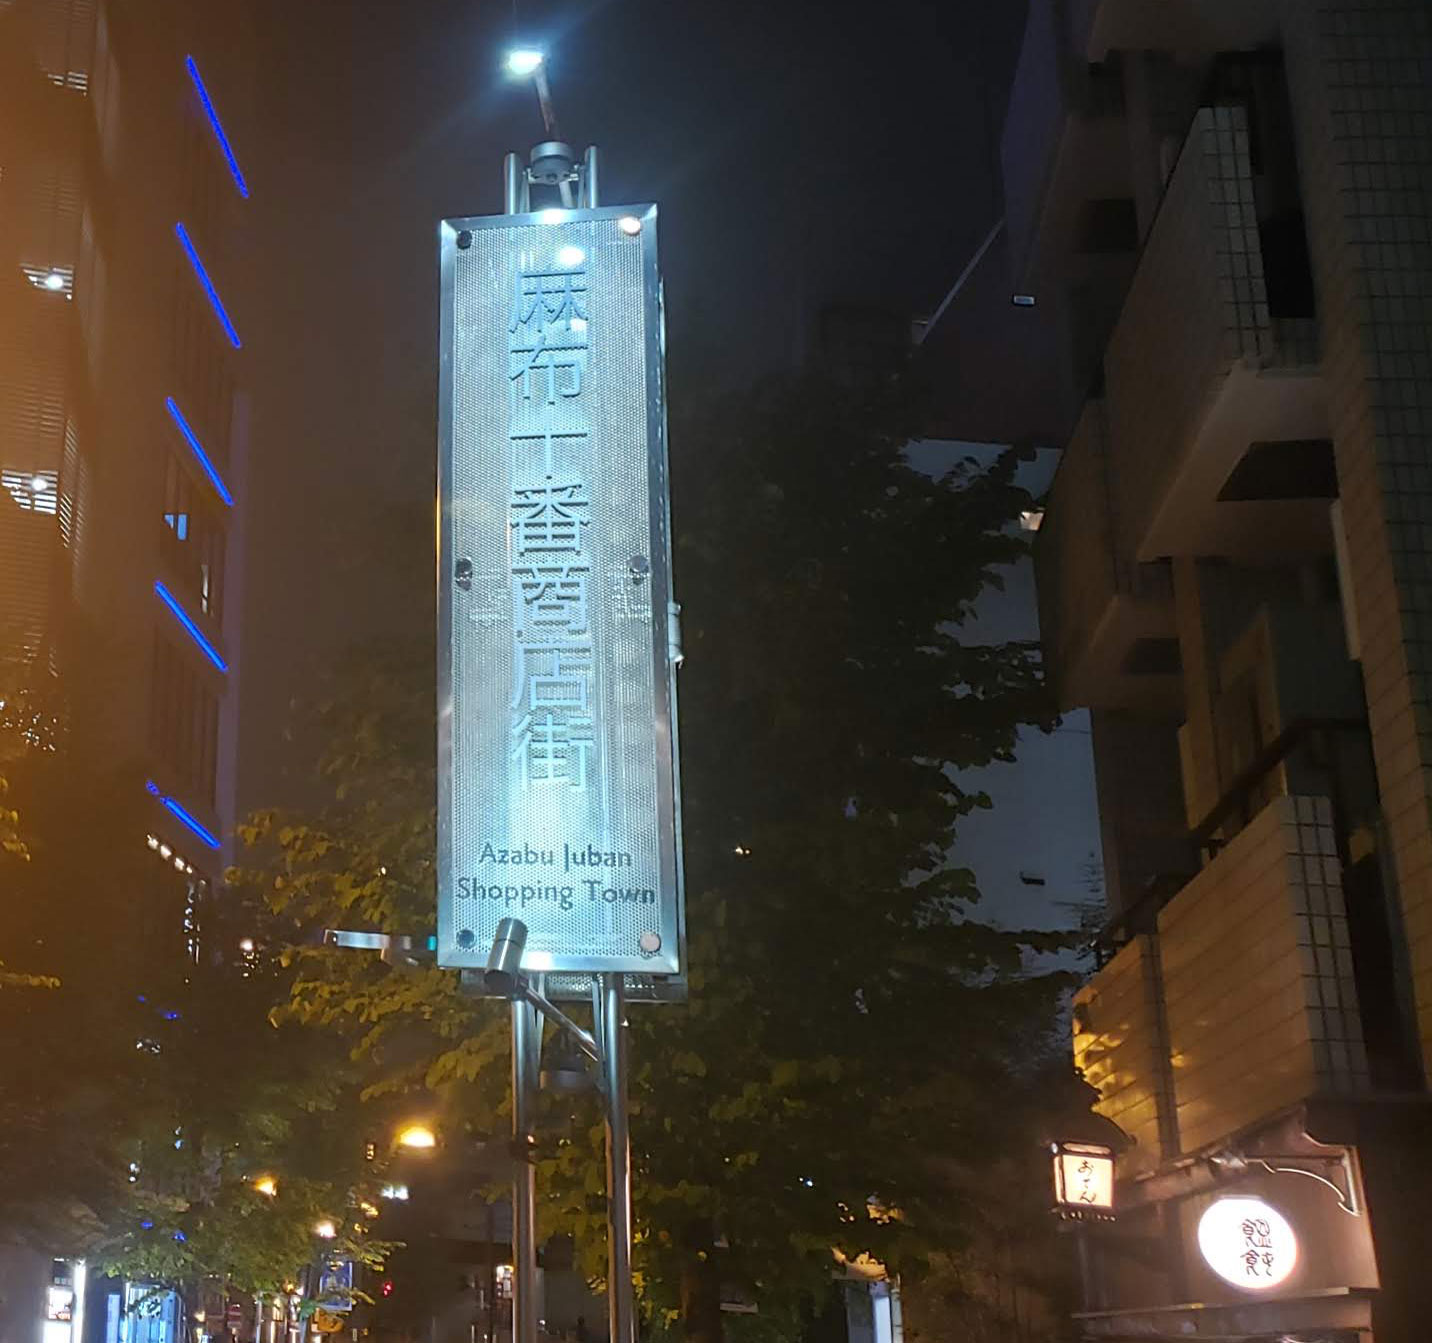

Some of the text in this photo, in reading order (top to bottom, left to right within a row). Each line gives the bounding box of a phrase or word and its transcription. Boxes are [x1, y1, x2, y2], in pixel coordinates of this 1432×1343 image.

[509, 264, 594, 792] 麻布十番商店街
[478, 842, 632, 872] Azabu Juban
[456, 876, 656, 911] Shopping Town
